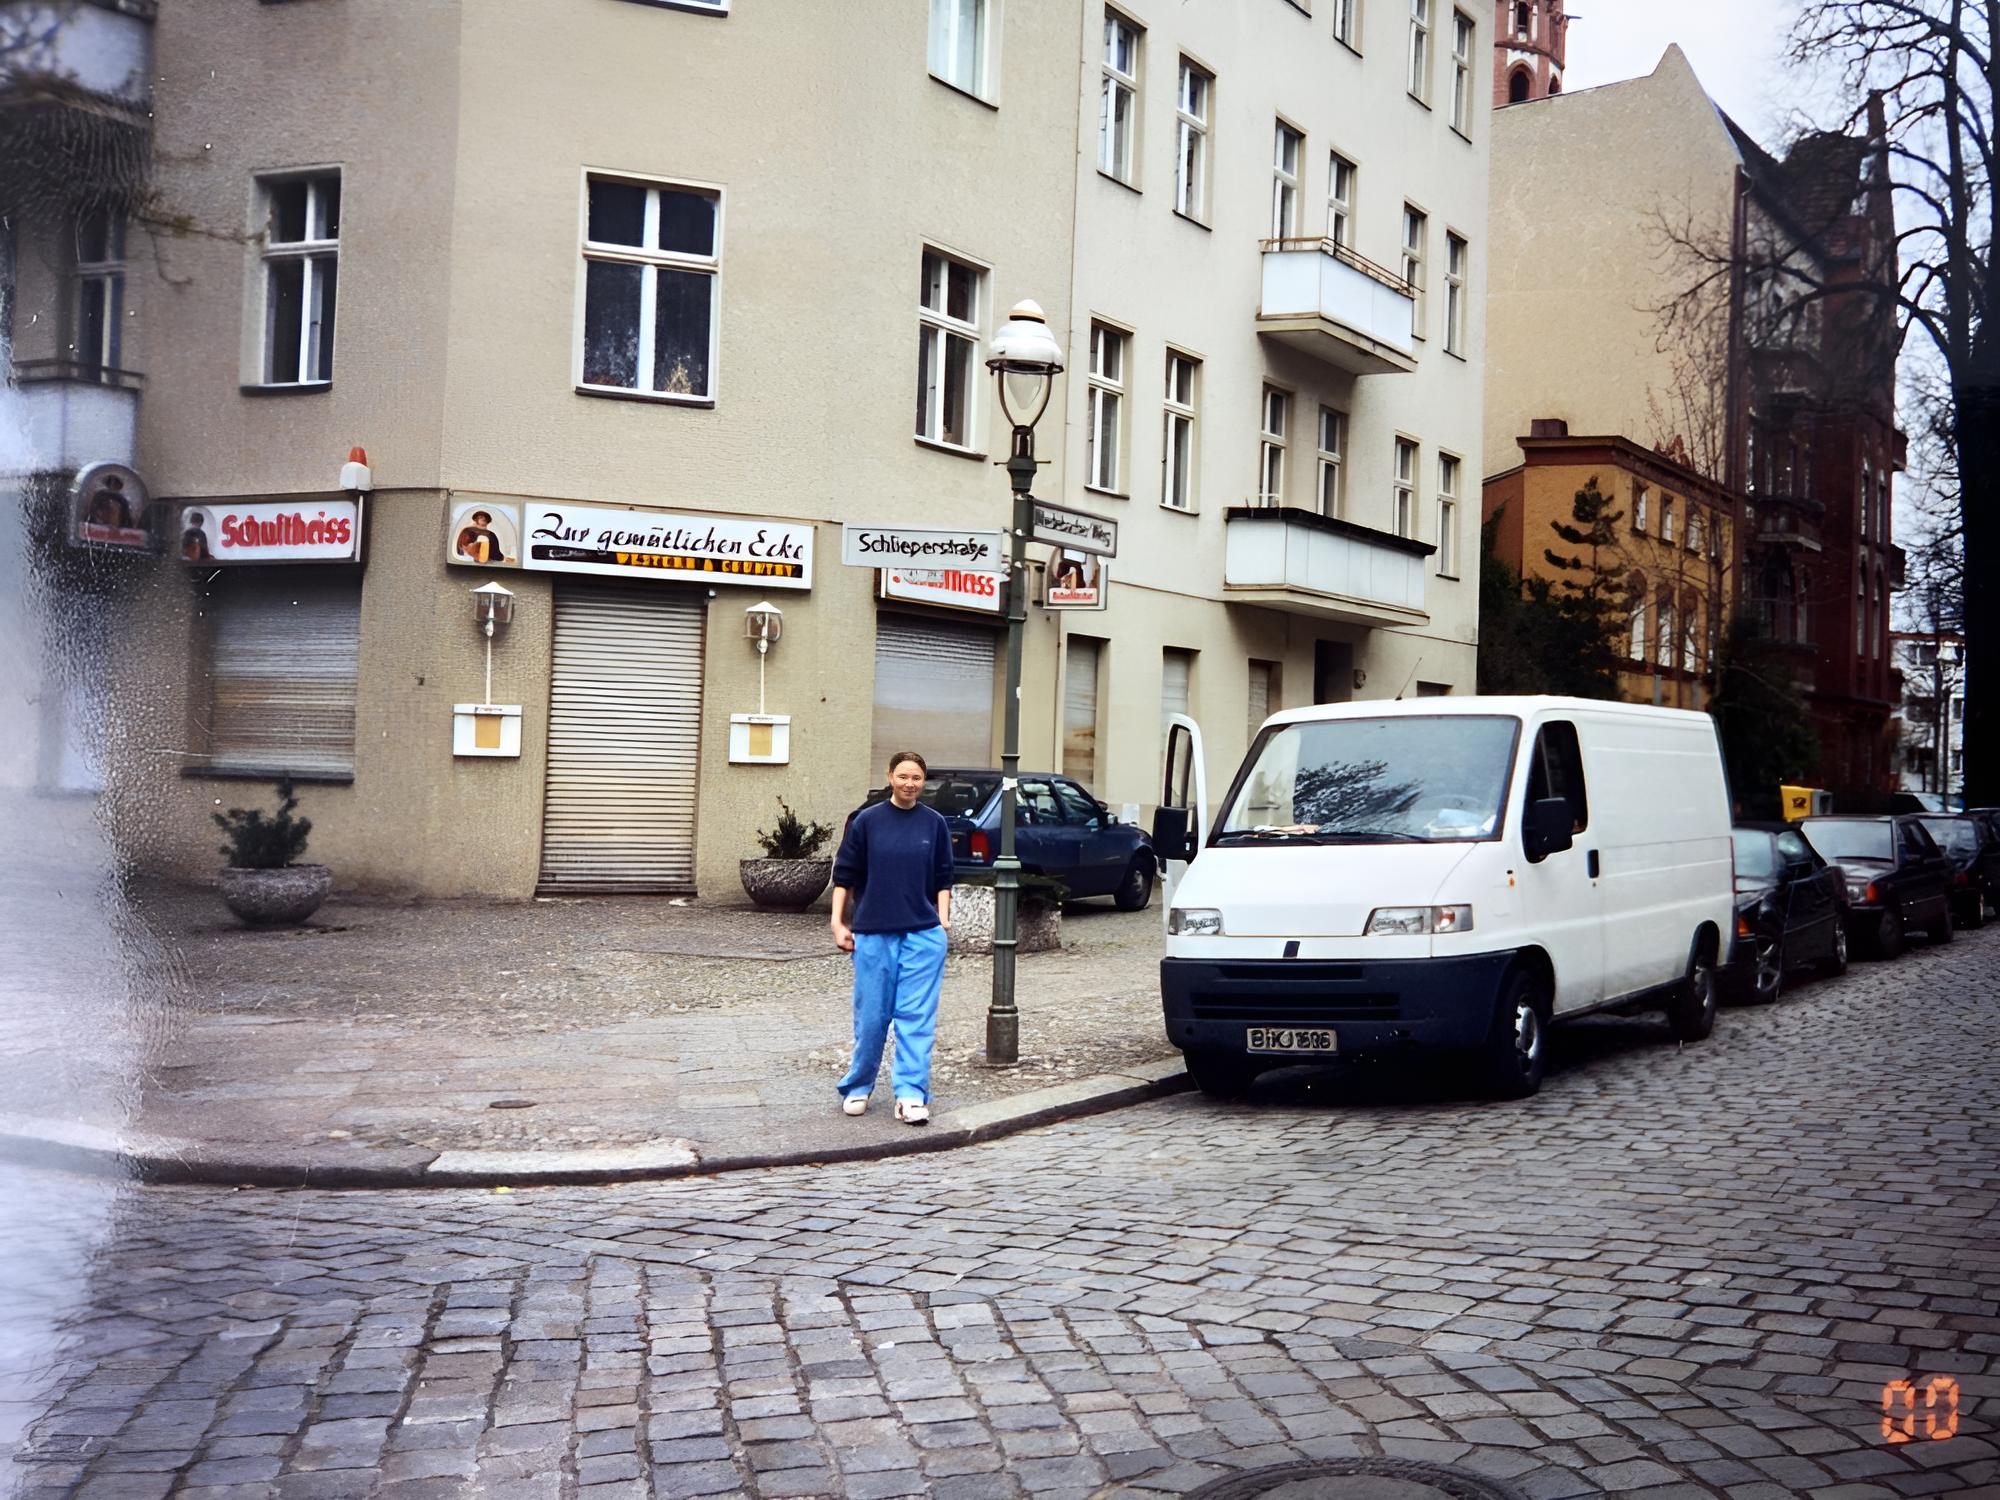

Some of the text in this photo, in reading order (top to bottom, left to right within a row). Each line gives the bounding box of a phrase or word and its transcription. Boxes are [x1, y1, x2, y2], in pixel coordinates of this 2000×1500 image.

[532, 512, 804, 559] Zur gemütlichen Ecke
